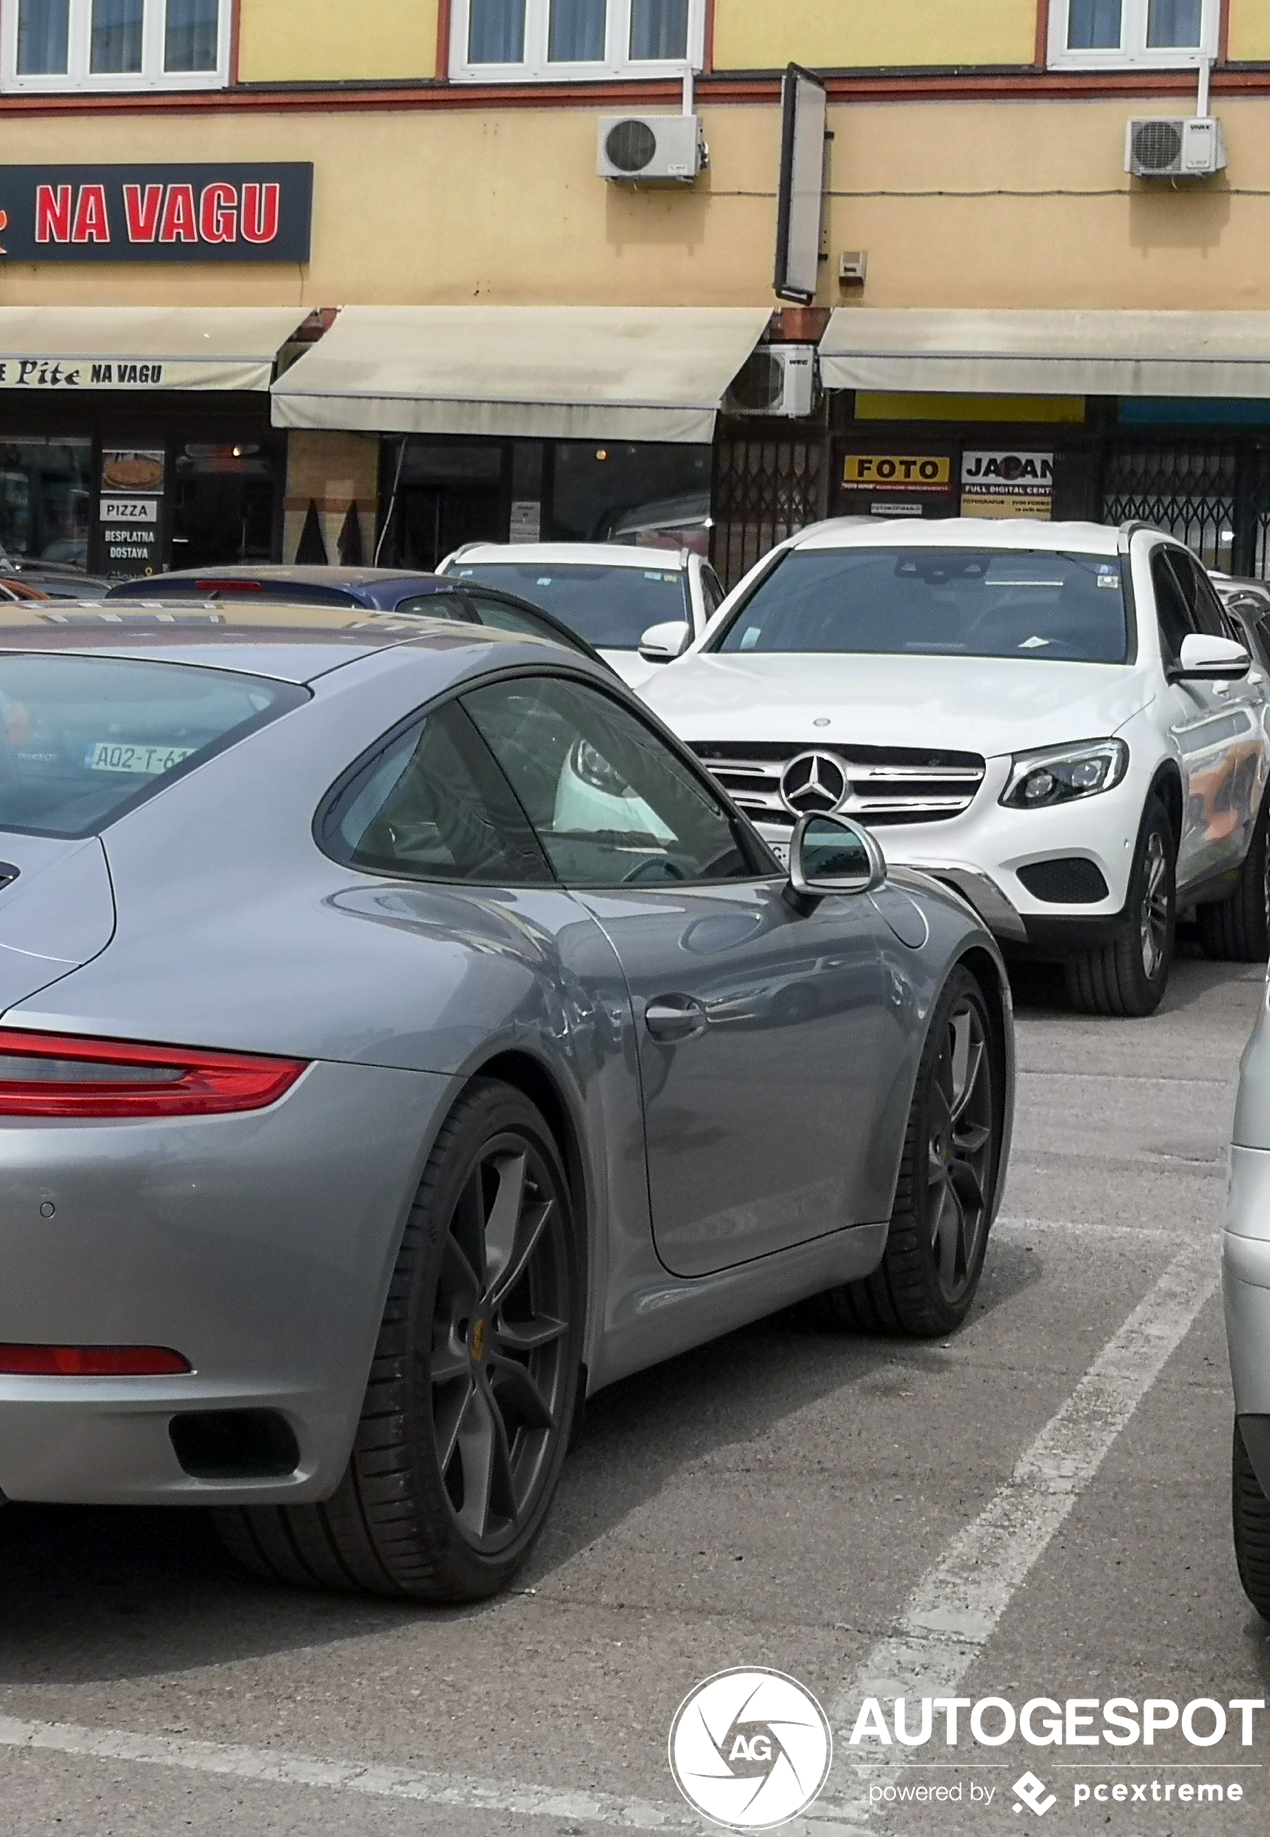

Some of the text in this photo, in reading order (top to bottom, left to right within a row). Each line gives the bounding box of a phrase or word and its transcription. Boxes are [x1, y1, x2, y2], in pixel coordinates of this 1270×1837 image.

[34, 184, 111, 244] NA
[121, 182, 281, 244] VAGU
[15, 360, 80, 386] Pite
[91, 364, 112, 383] NA
[117, 365, 163, 383] VAGU
[857, 459, 939, 479] FOTO
[965, 485, 1052, 495] FULL DIGITAL CENT
[107, 505, 148, 517] PIZZA
[105, 530, 155, 542] BESPLATNA
[110, 547, 148, 559] DOSTAVA
